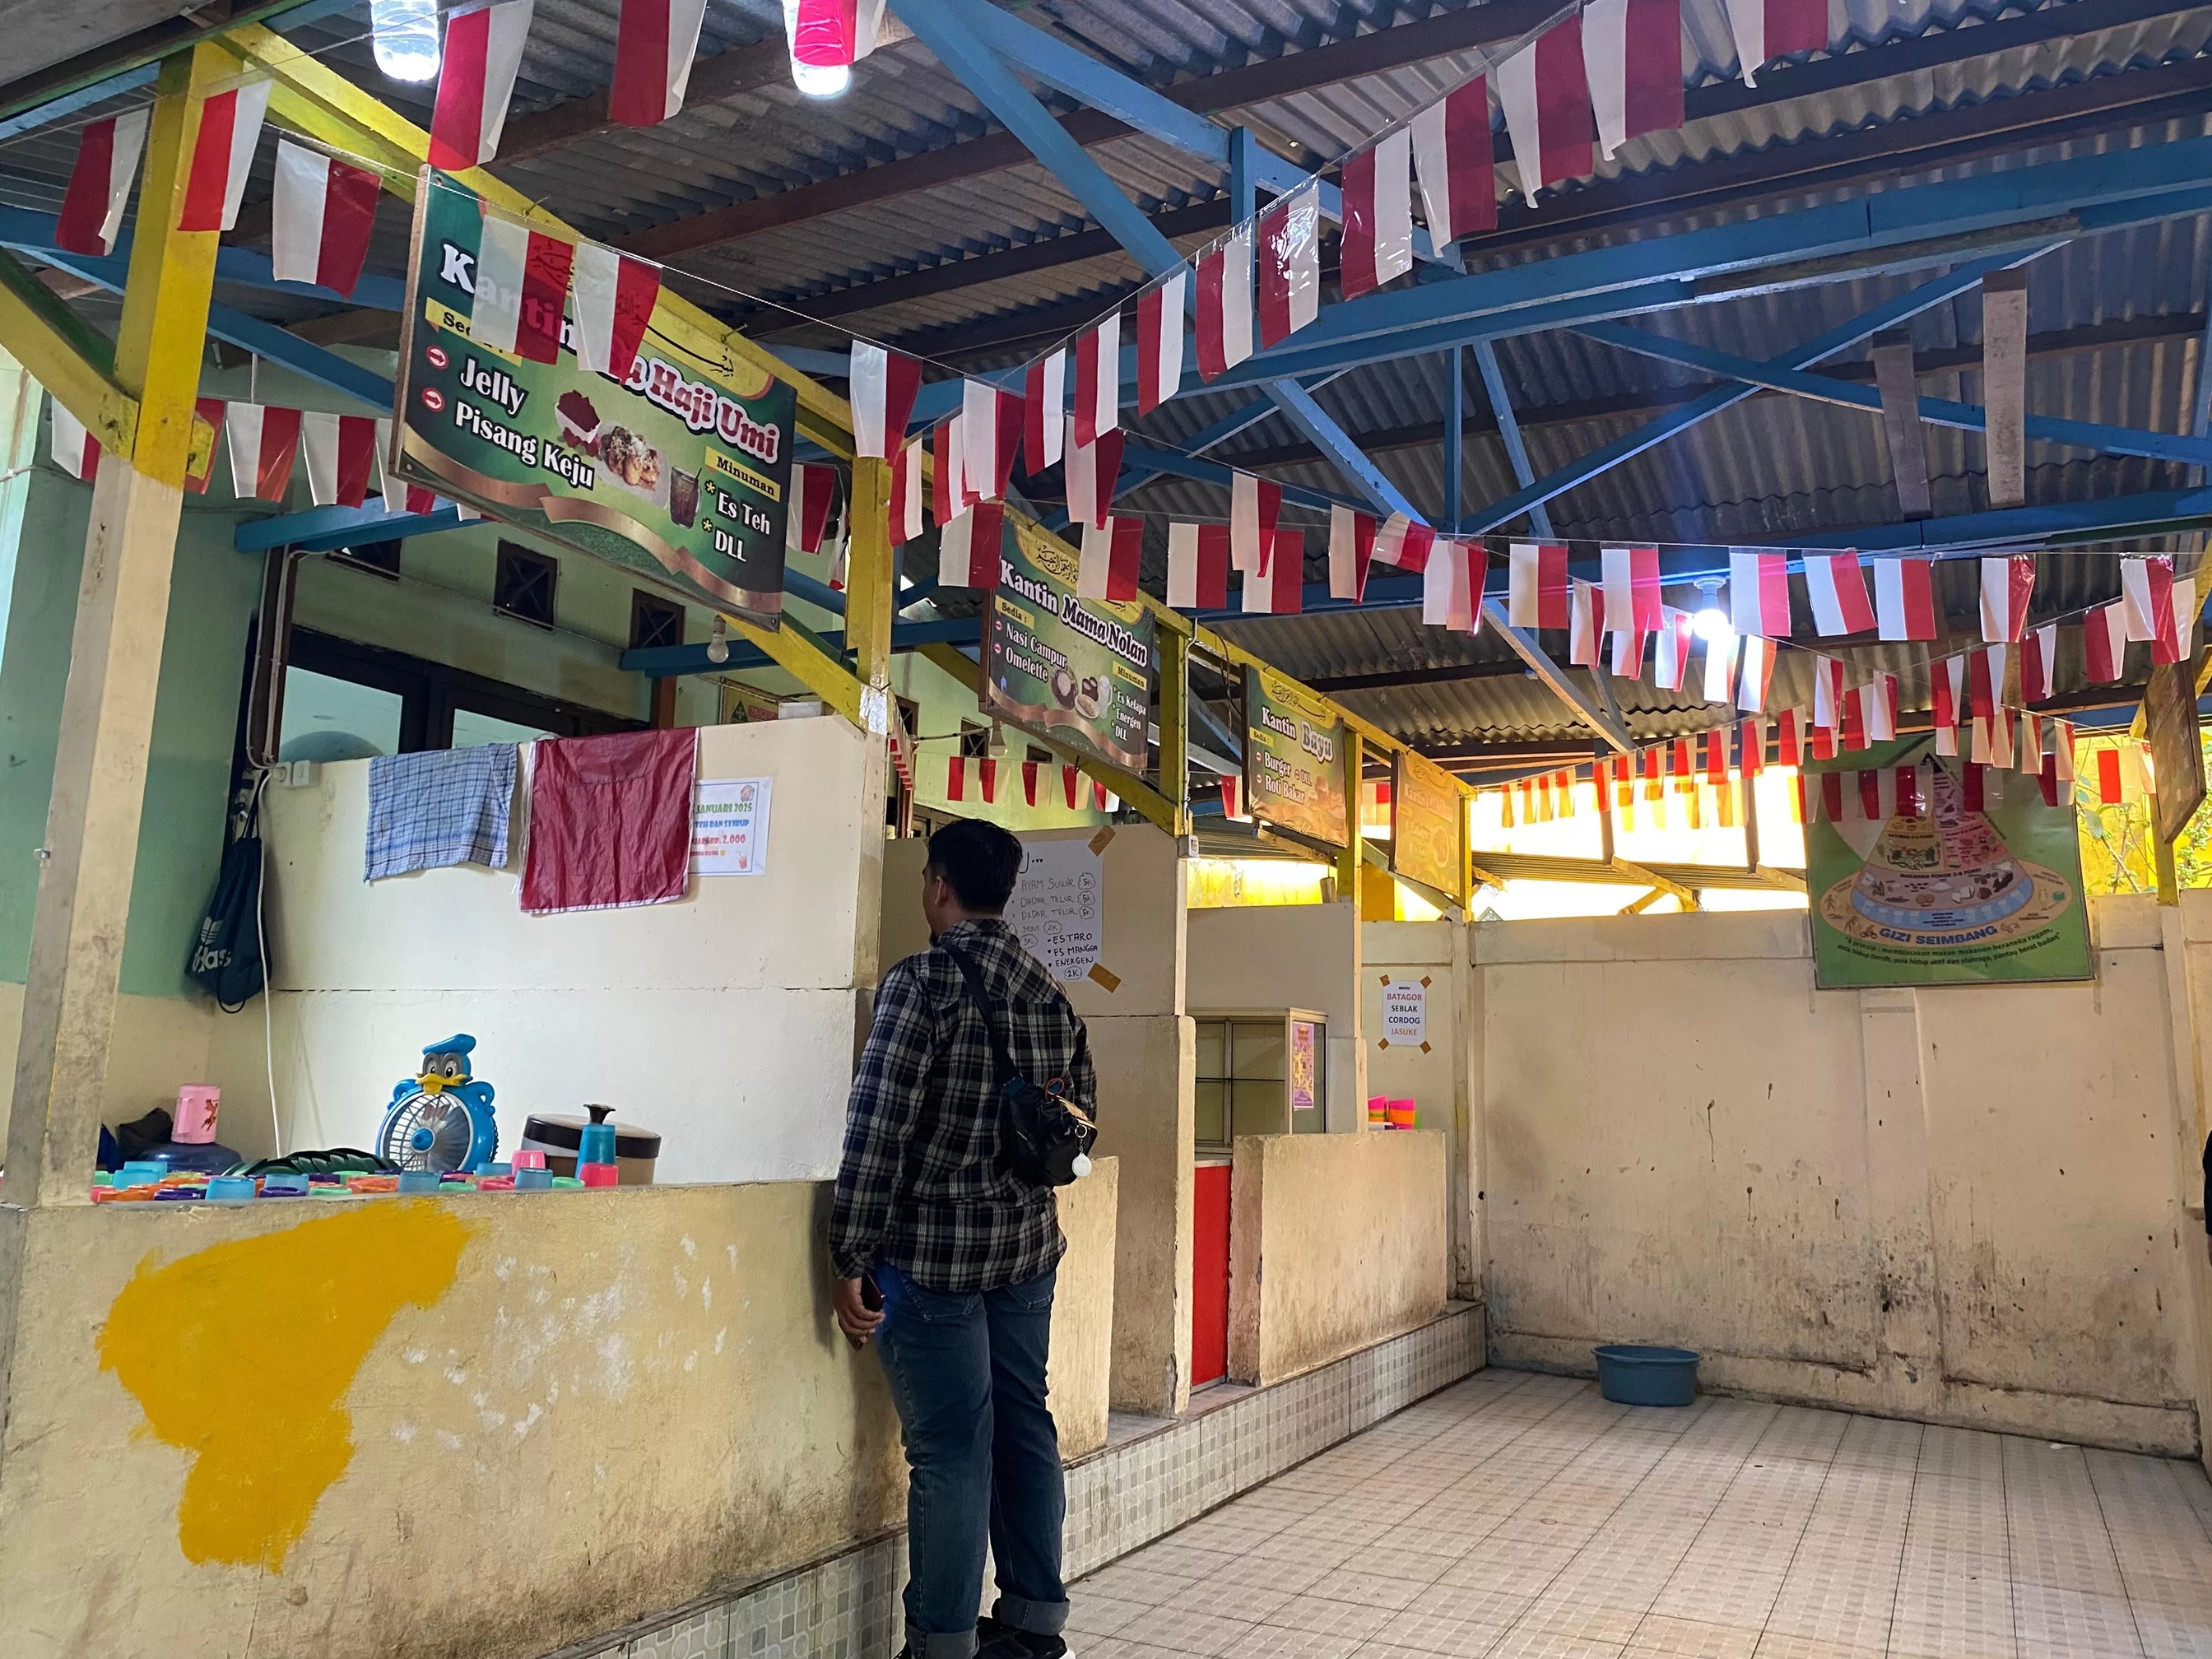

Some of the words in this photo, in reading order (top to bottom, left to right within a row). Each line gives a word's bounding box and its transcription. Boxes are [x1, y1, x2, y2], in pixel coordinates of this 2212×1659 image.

[460, 357, 526, 416] Jelly
[648, 363, 714, 425] Haji
[720, 401, 778, 458] Umi
[455, 400, 537, 466] Pisang
[543, 443, 593, 488] Keju
[716, 455, 776, 497] Minuman
[718, 491, 737, 519] Es
[742, 503, 771, 536] Teh
[714, 529, 747, 563] DLL
[1000, 559, 1058, 614] Kantin
[1001, 602, 1023, 621] Sedia
[1062, 597, 1106, 641] Mama
[1108, 623, 1146, 664] Nolan
[1006, 622, 1028, 648] Nasi
[1030, 636, 1067, 667] Campur
[1006, 647, 1048, 682] Omelette
[1118, 666, 1146, 688] Minuman
[1117, 690, 1125, 704] Es
[1126, 695, 1146, 716] Kelapa
[1116, 709, 1141, 730] Energen
[1115, 726, 1128, 741] DLL
[1262, 706, 1297, 740] Kantin
[1302, 723, 1332, 758] Bayu
[1264, 751, 1291, 777] Burger
[1300, 769, 1312, 786] DLL
[1265, 774, 1281, 796] Roti
[1283, 781, 1305, 805] Bakar
[734, 802, 752, 812] 2025
[1021, 879, 1044, 892] AYAM
[1050, 908, 1078, 916] TELUR
[1023, 925, 1040, 933] MINI
[1053, 934, 1066, 944] ES
[1066, 932, 1093, 942] TARO
[1880, 927, 1912, 943] GIZI
[1915, 926, 1998, 945] SEIMBANG
[1053, 948, 1065, 956] ES
[1067, 945, 1098, 955] MANGGA
[1992, 937, 2028, 950] beraneka
[2018, 943, 2038, 954] berat
[1055, 956, 1094, 967] ENERGEN
[1066, 969, 1080, 978] 2K
[1387, 993, 1422, 1001] BATAGOR
